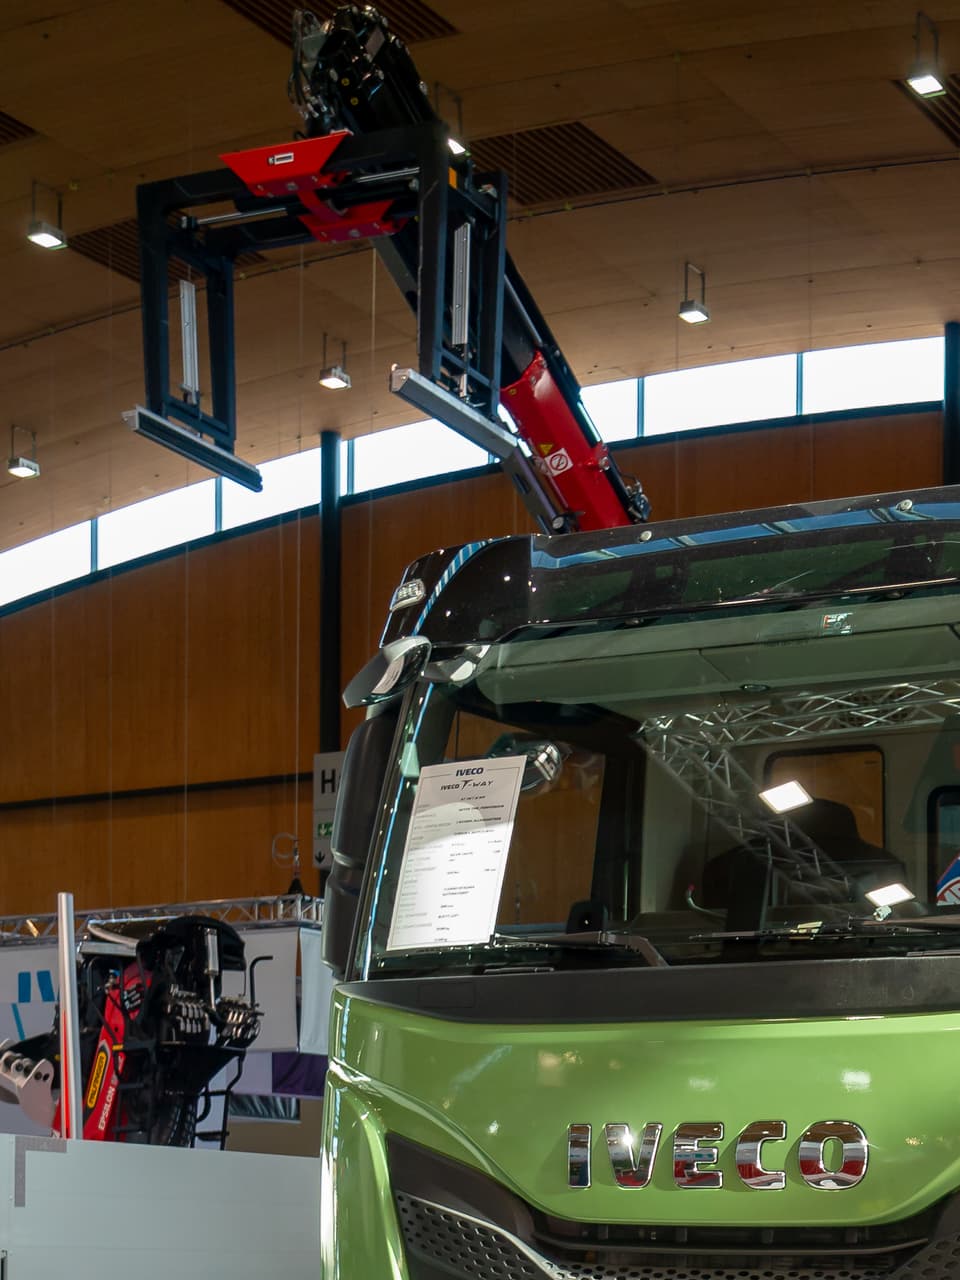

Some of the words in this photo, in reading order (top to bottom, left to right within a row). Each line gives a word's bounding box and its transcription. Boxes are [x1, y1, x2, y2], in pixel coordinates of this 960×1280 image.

[455, 767, 484, 777] IVECO
[440, 783, 461, 791] IVECO
[98, 1086, 116, 1131] EPSILON
[566, 1119, 870, 1191] IVECO
